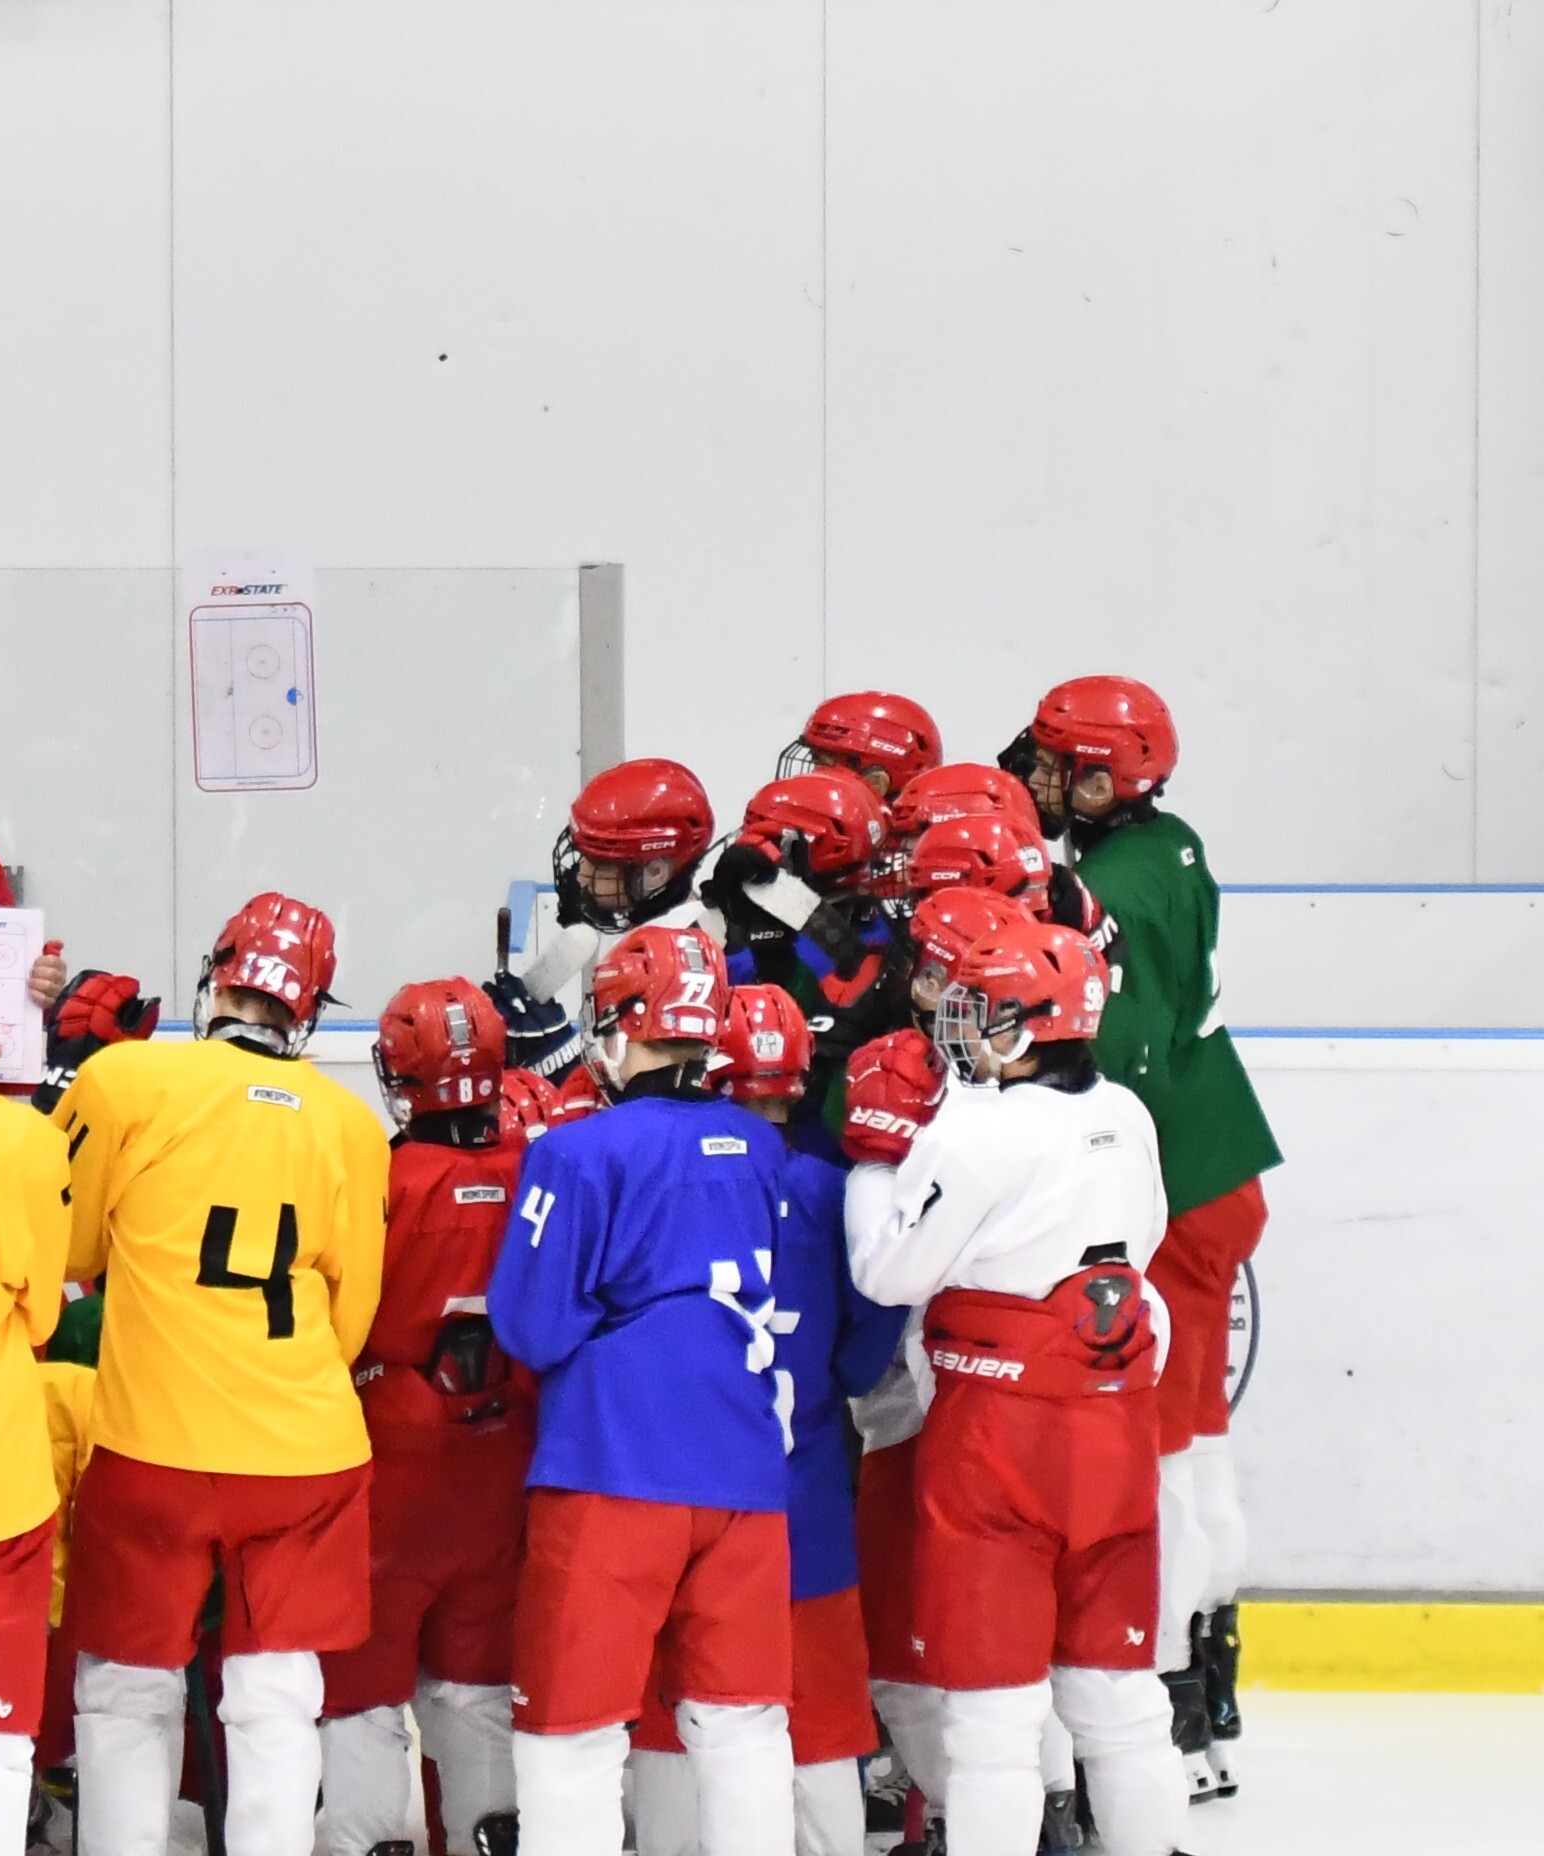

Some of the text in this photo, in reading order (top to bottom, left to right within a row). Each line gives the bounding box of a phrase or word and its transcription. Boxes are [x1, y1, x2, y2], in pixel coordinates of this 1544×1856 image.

[679, 971, 716, 1005] 77
[520, 1185, 556, 1248] 4
[197, 1203, 298, 1339] 4
[933, 1349, 1025, 1382] BAUER
